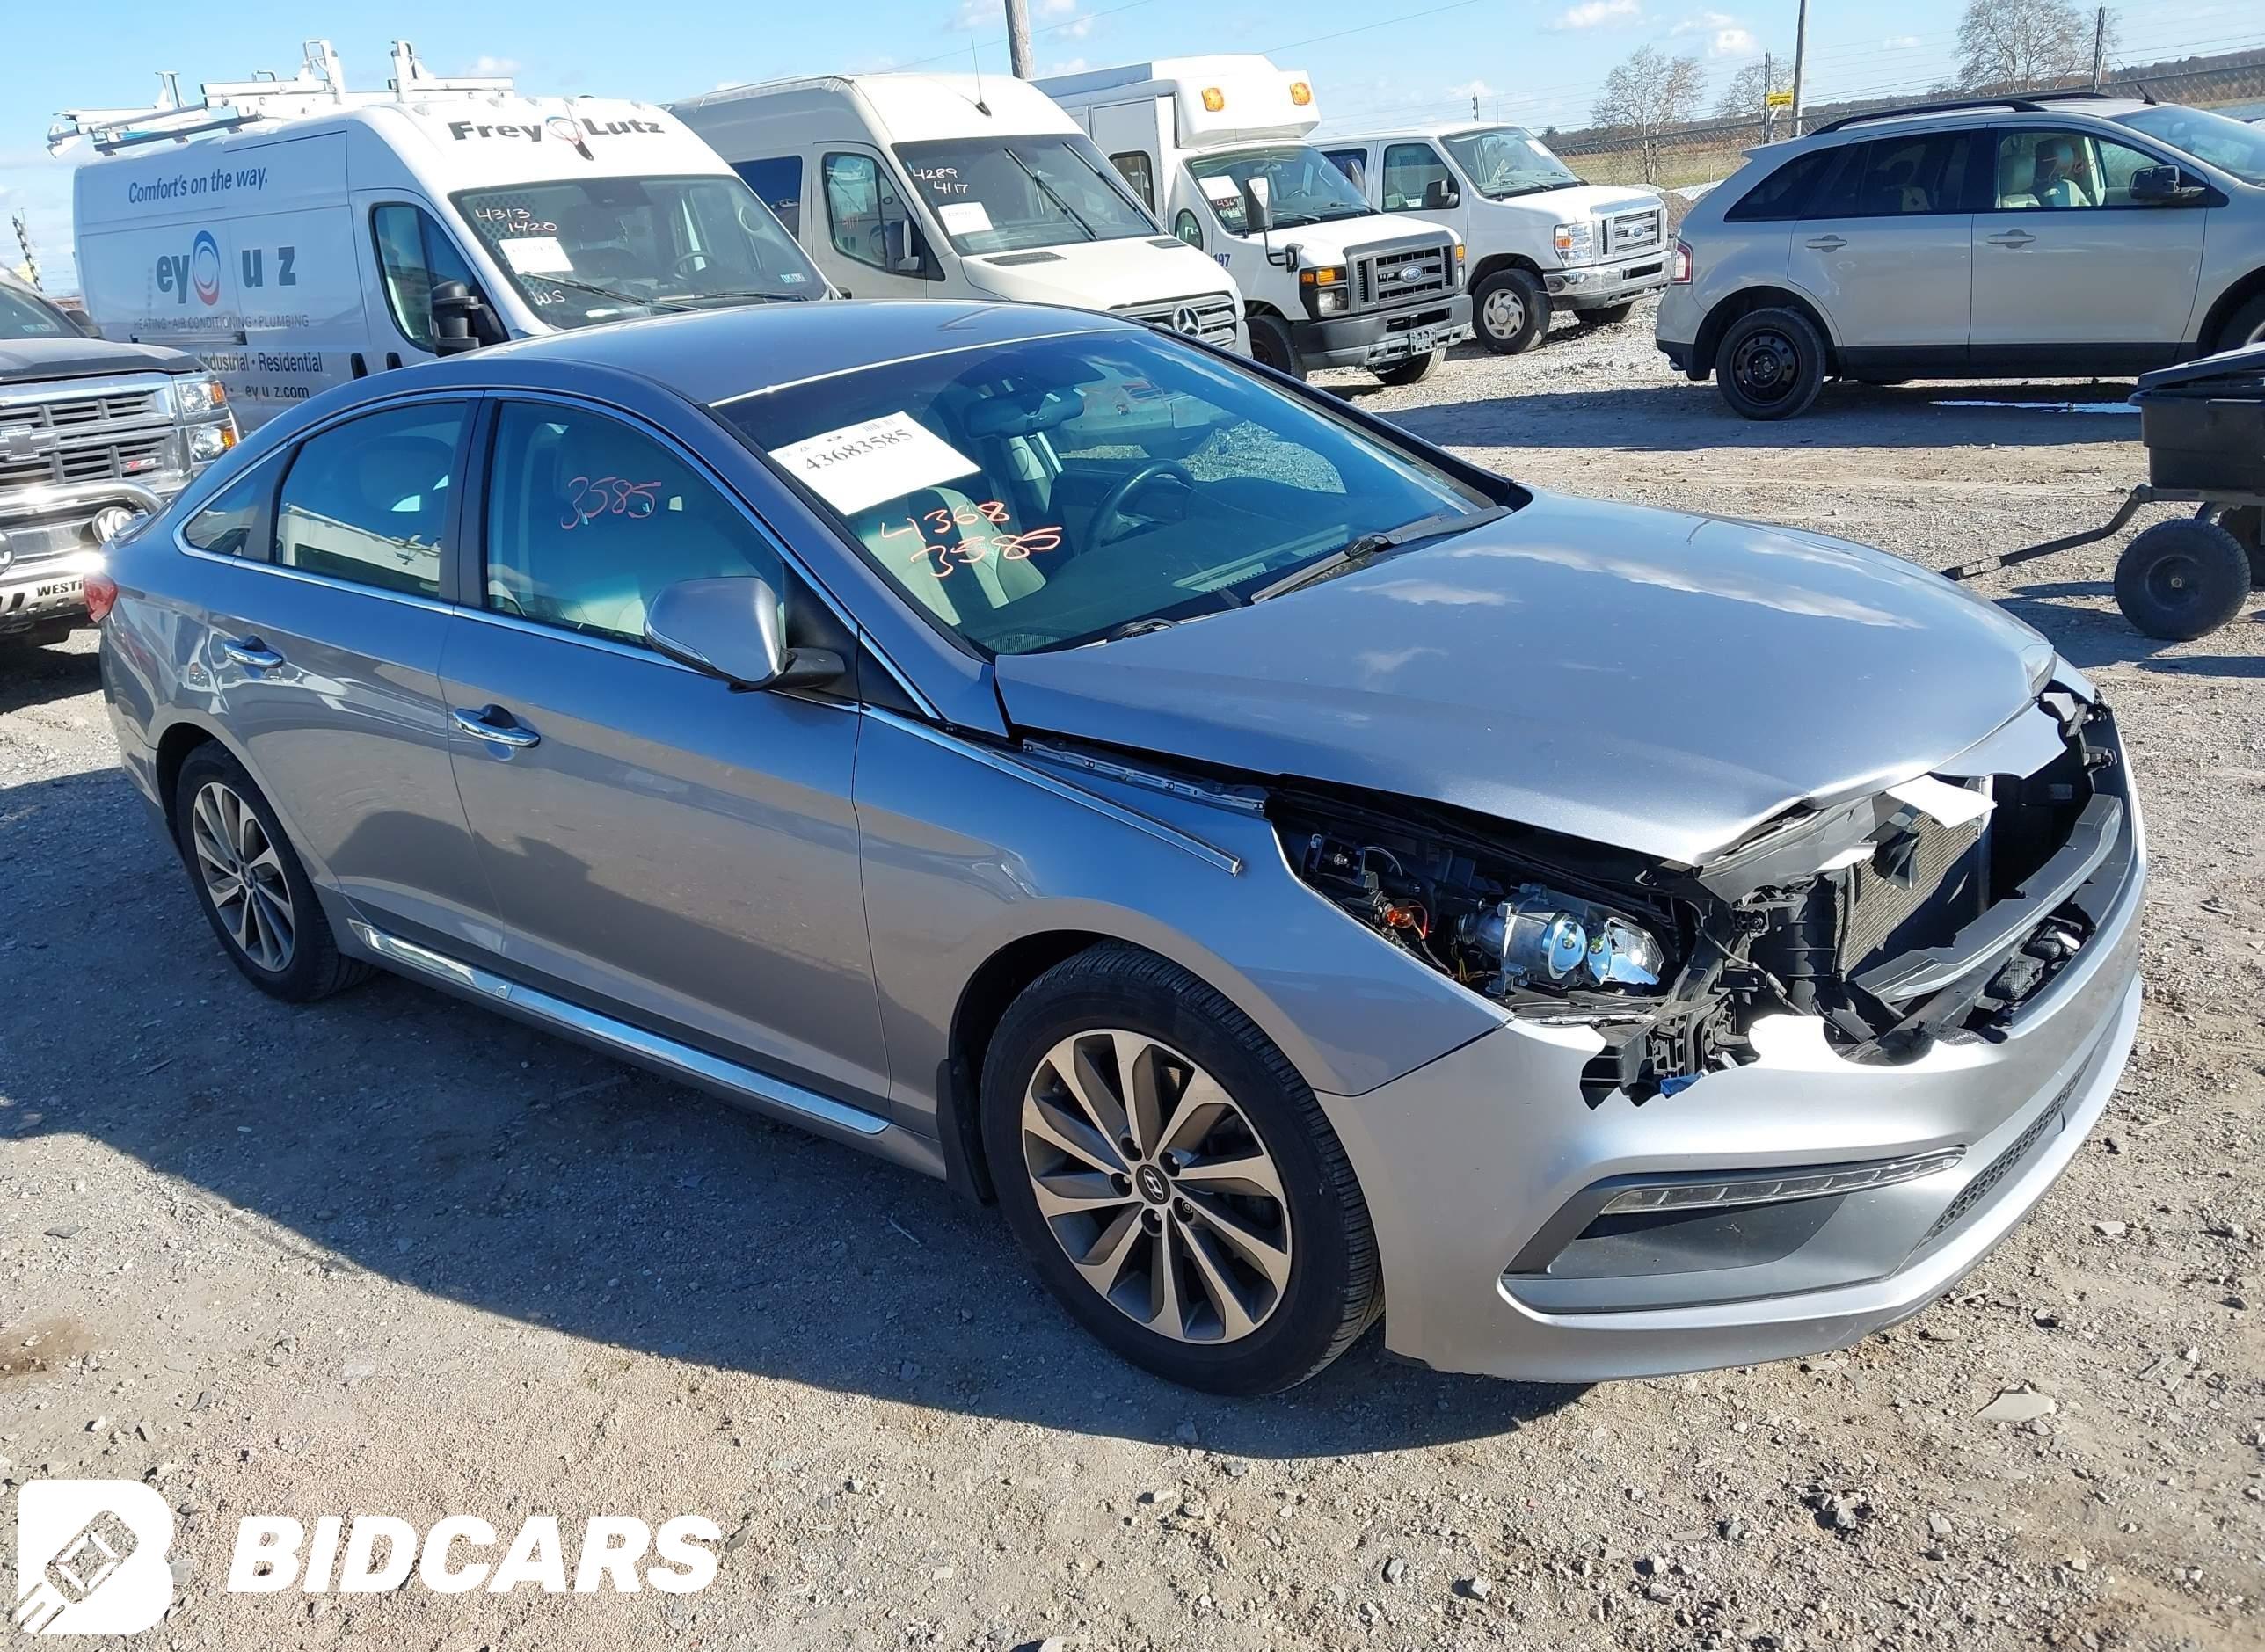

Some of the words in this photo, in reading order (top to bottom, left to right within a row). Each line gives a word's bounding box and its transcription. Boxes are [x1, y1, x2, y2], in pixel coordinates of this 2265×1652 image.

[447, 120, 542, 142] Frey
[580, 118, 666, 135] Lutz
[128, 175, 186, 204] Comfort's
[191, 176, 207, 194] on
[211, 169, 232, 192] the
[236, 167, 268, 190] way.
[912, 168, 958, 180] 4289
[933, 181, 969, 194] 4117
[475, 208, 531, 221] 4313
[508, 222, 557, 233] 1420
[134, 317, 168, 331] HEATING
[172, 317, 186, 330] AIR
[187, 316, 251, 330] CONDITIONING
[259, 315, 309, 328] PLUMBING
[258, 352, 324, 374] Residential
[806, 428, 913, 469] 43683585
[560, 476, 661, 530] 3585
[881, 501, 1010, 542] 4368
[910, 527, 1062, 577] 3585
